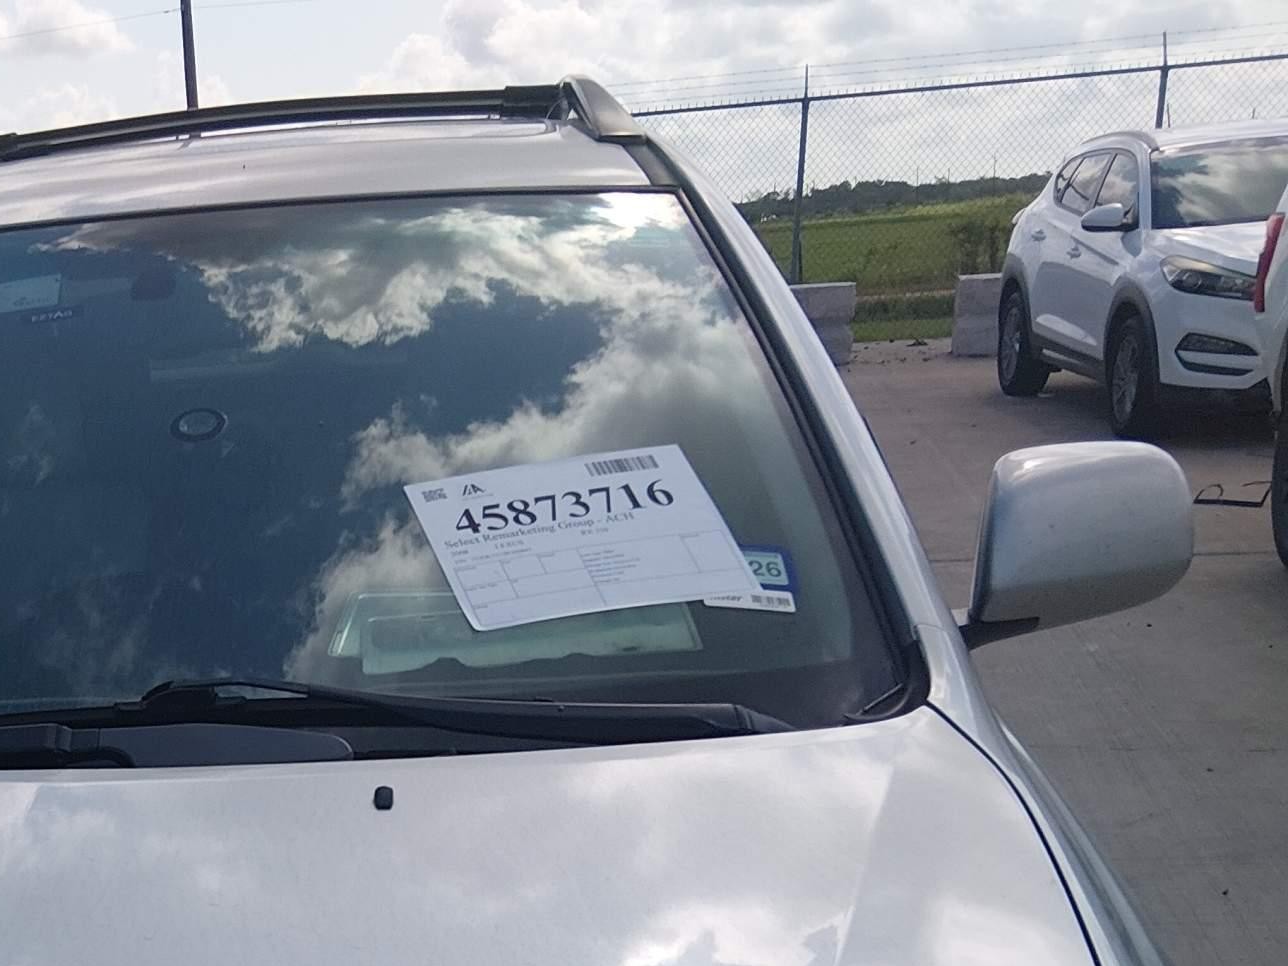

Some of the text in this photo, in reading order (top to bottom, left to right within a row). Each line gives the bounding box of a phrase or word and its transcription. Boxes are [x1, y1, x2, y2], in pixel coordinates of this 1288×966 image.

[455, 479, 674, 534] 45873716
[444, 537, 481, 549] Select
[482, 526, 557, 543] Remarketing
[558, 518, 595, 530] Group
[748, 560, 782, 577] 26
